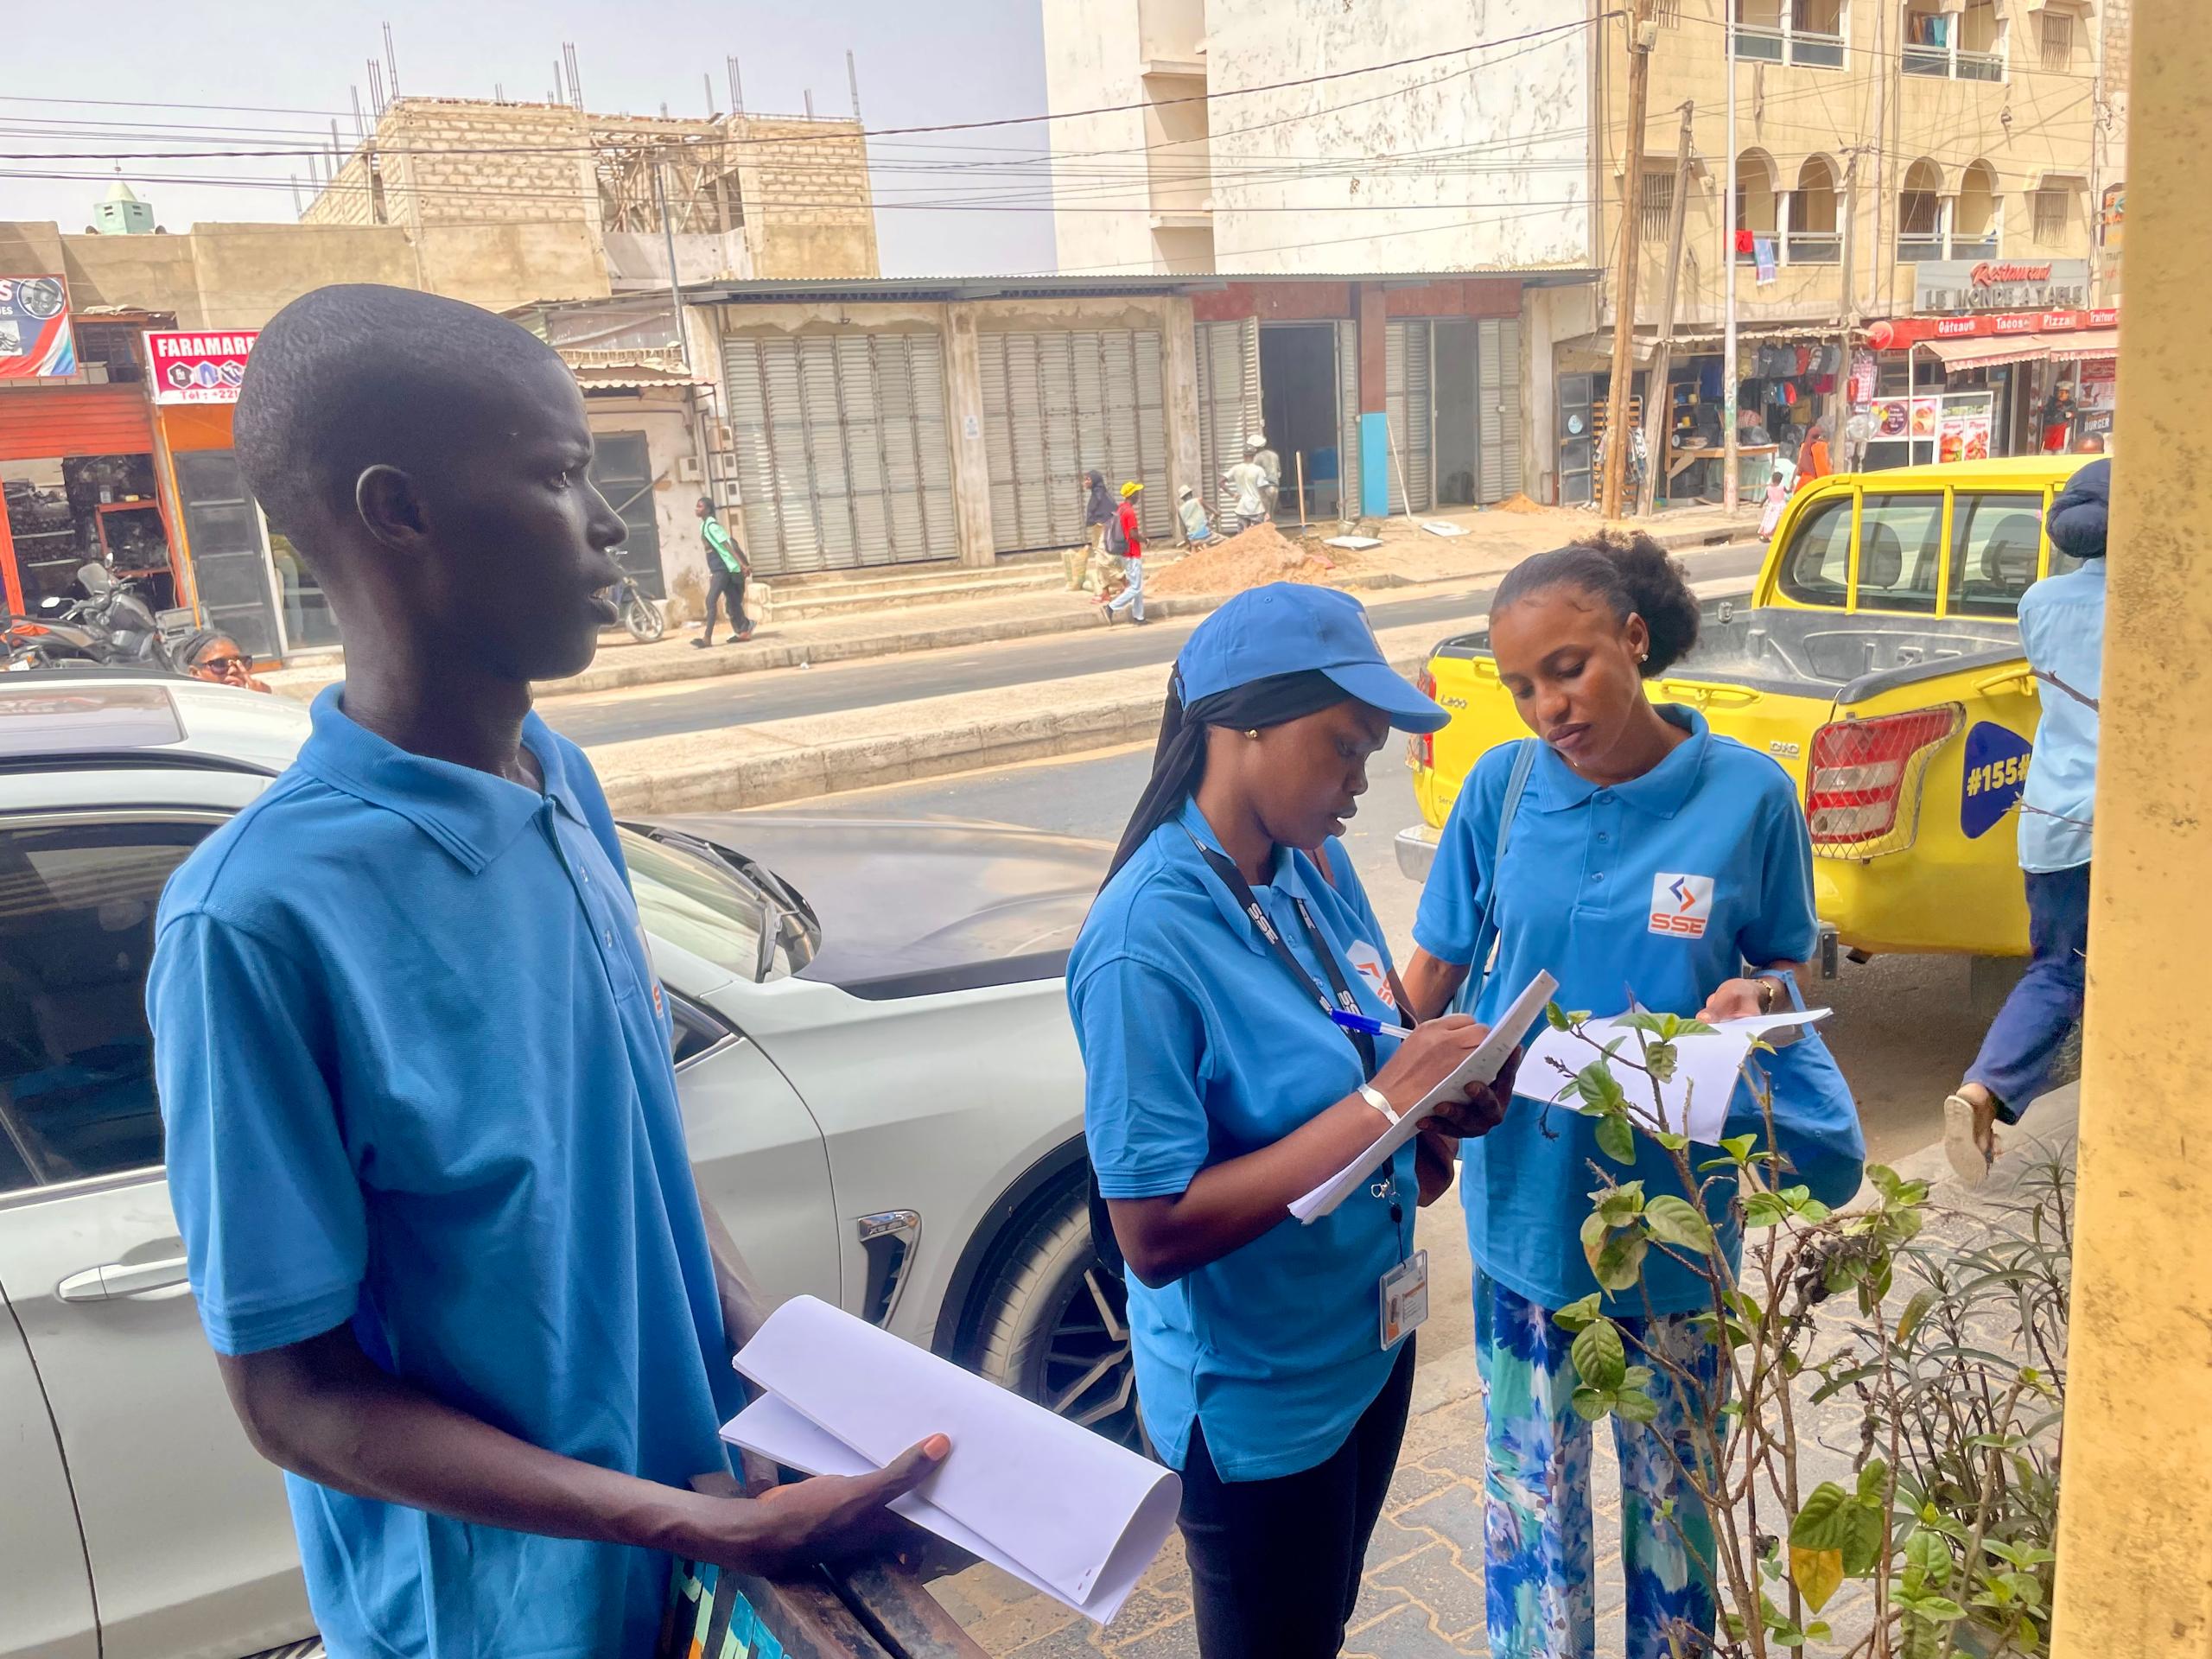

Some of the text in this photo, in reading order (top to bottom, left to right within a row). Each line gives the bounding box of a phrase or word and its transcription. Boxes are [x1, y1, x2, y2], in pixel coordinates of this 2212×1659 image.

[1970, 262, 2052, 287] Restaurant
[1925, 289, 1947, 309] LE
[1954, 288, 2014, 308] MONDE
[2036, 285, 2082, 305] TABLE
[1996, 317, 2023, 330] Tacos
[2044, 315, 2070, 327] Pizza
[2084, 417, 2110, 432] BURGER
[1967, 753, 2031, 797] #155#
[1247, 902, 1279, 944] SSE
[1651, 912, 1706, 934] SSE
